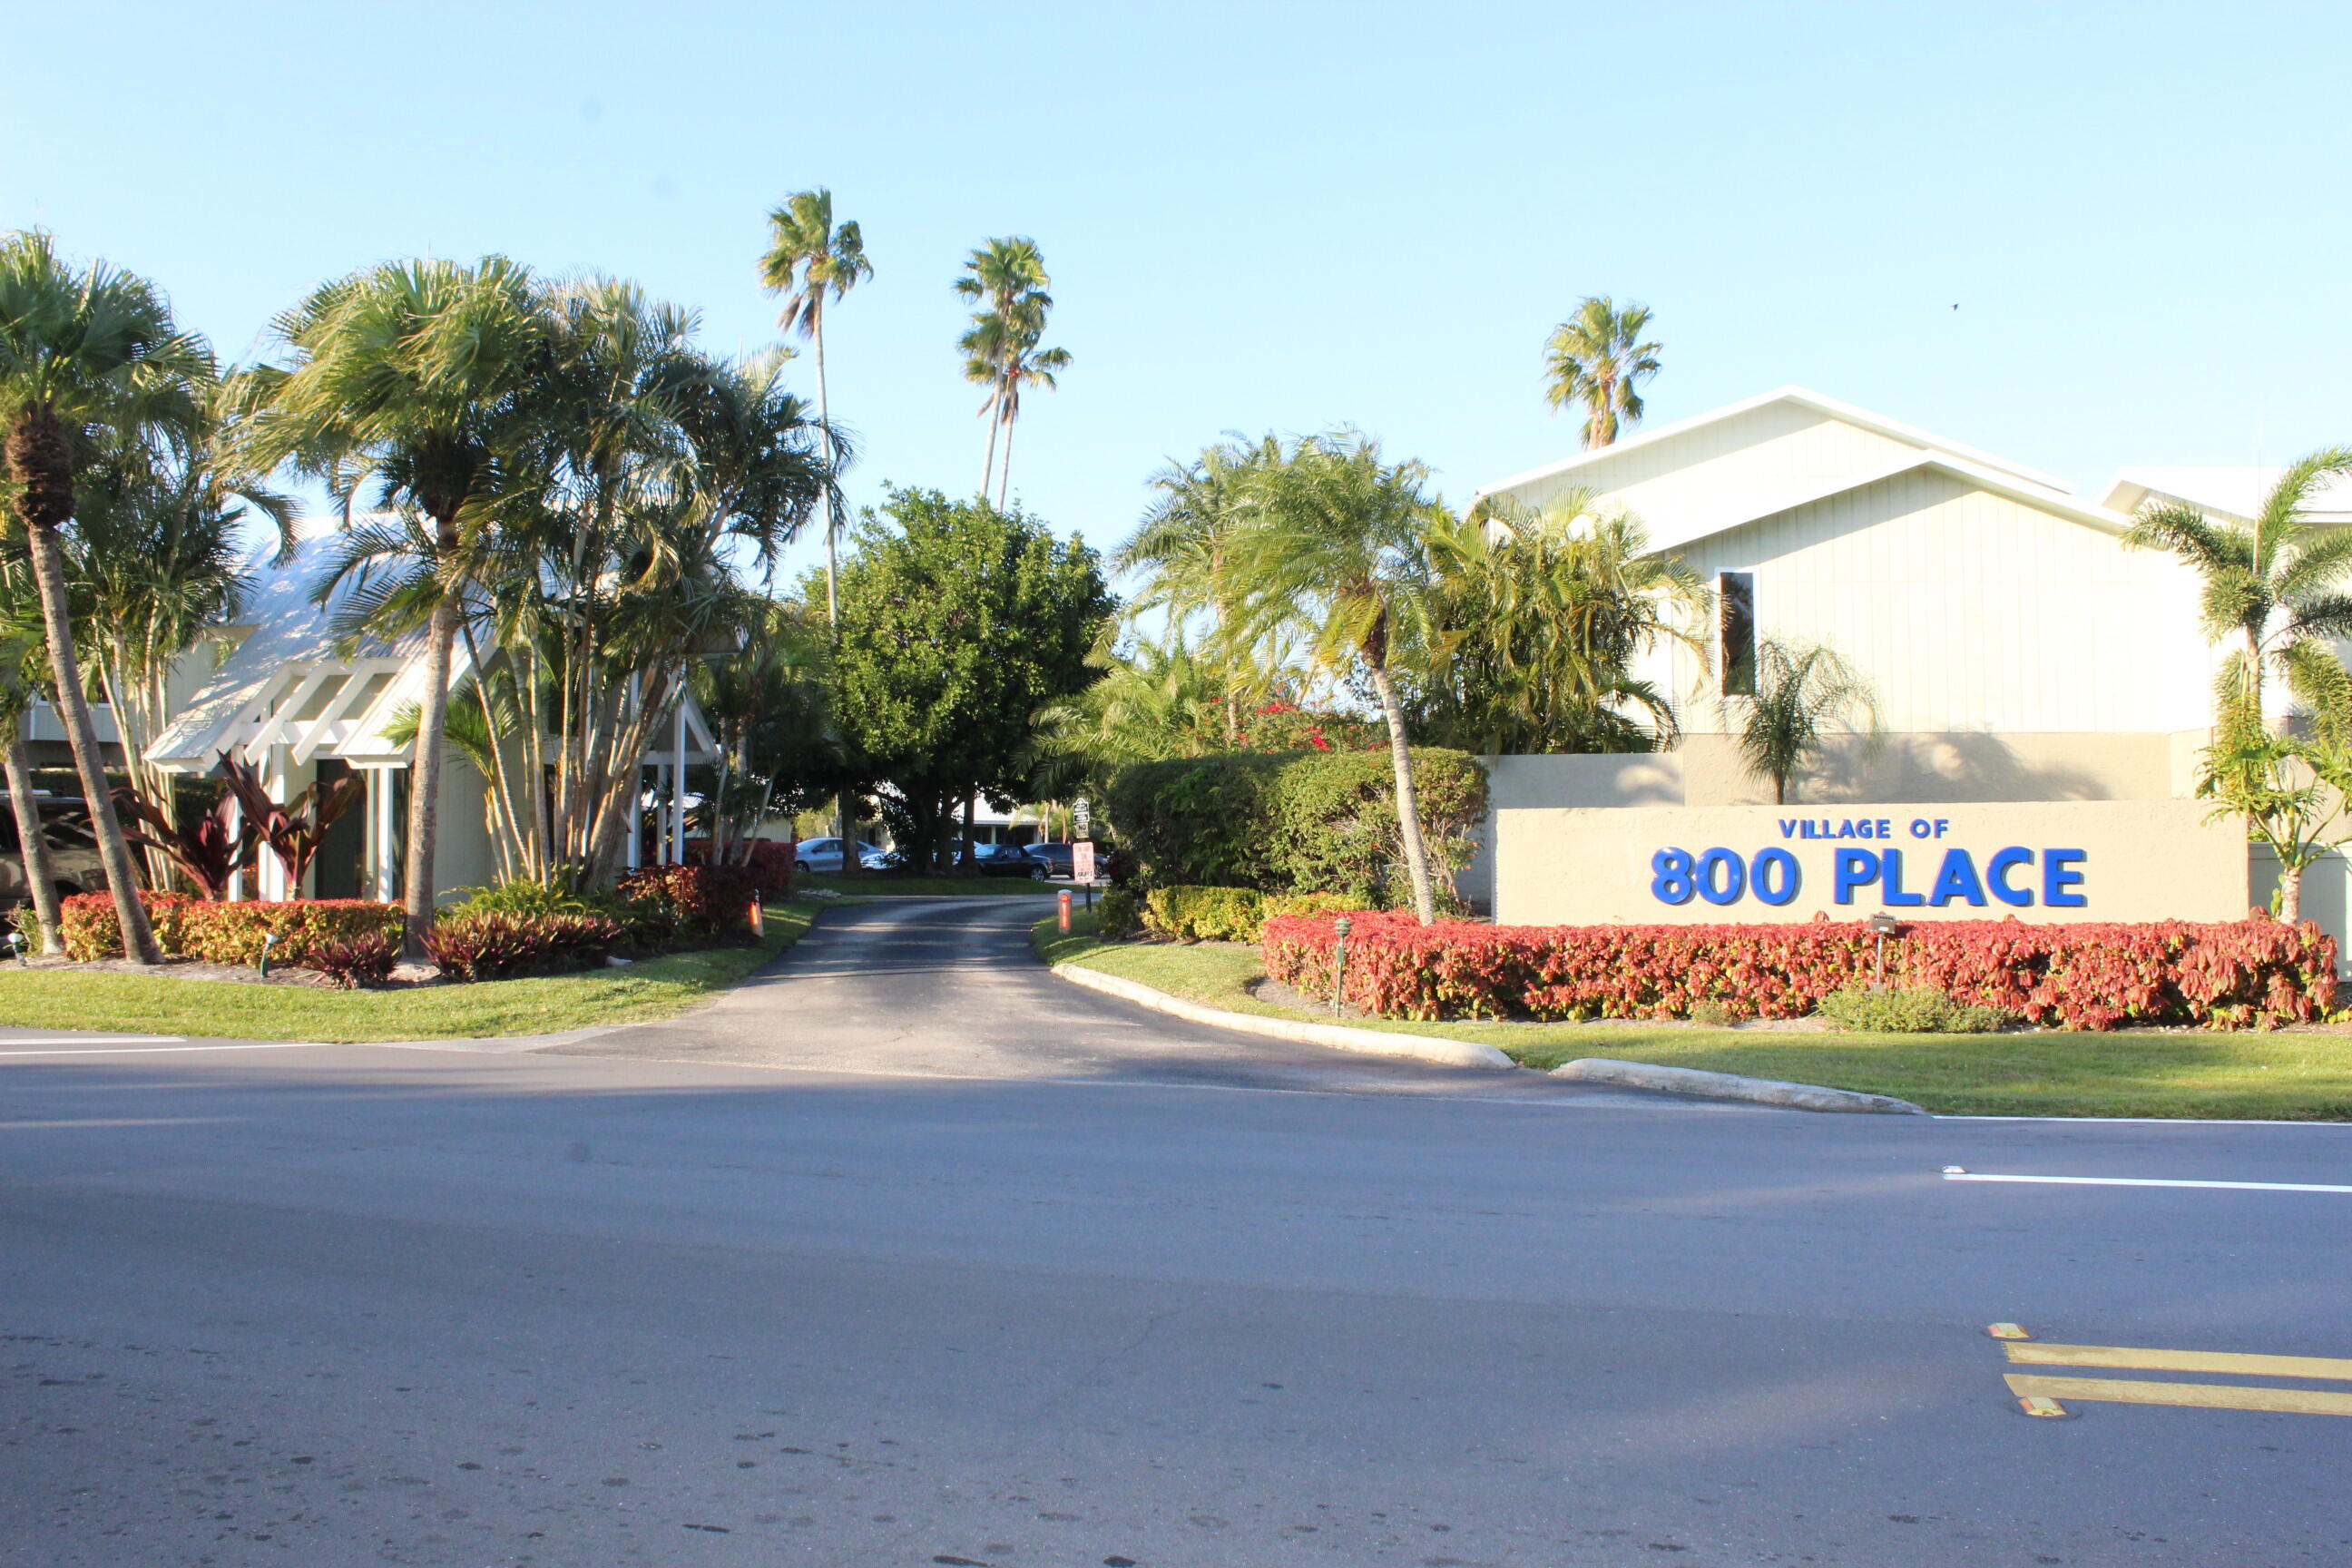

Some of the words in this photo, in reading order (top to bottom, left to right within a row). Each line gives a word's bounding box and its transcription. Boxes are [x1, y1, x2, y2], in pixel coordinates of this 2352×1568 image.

[1779, 818, 1890, 839] VILLAGE
[1909, 818, 1949, 838] OF
[1651, 847, 1800, 906] 800
[1834, 847, 2085, 906] PLACE
